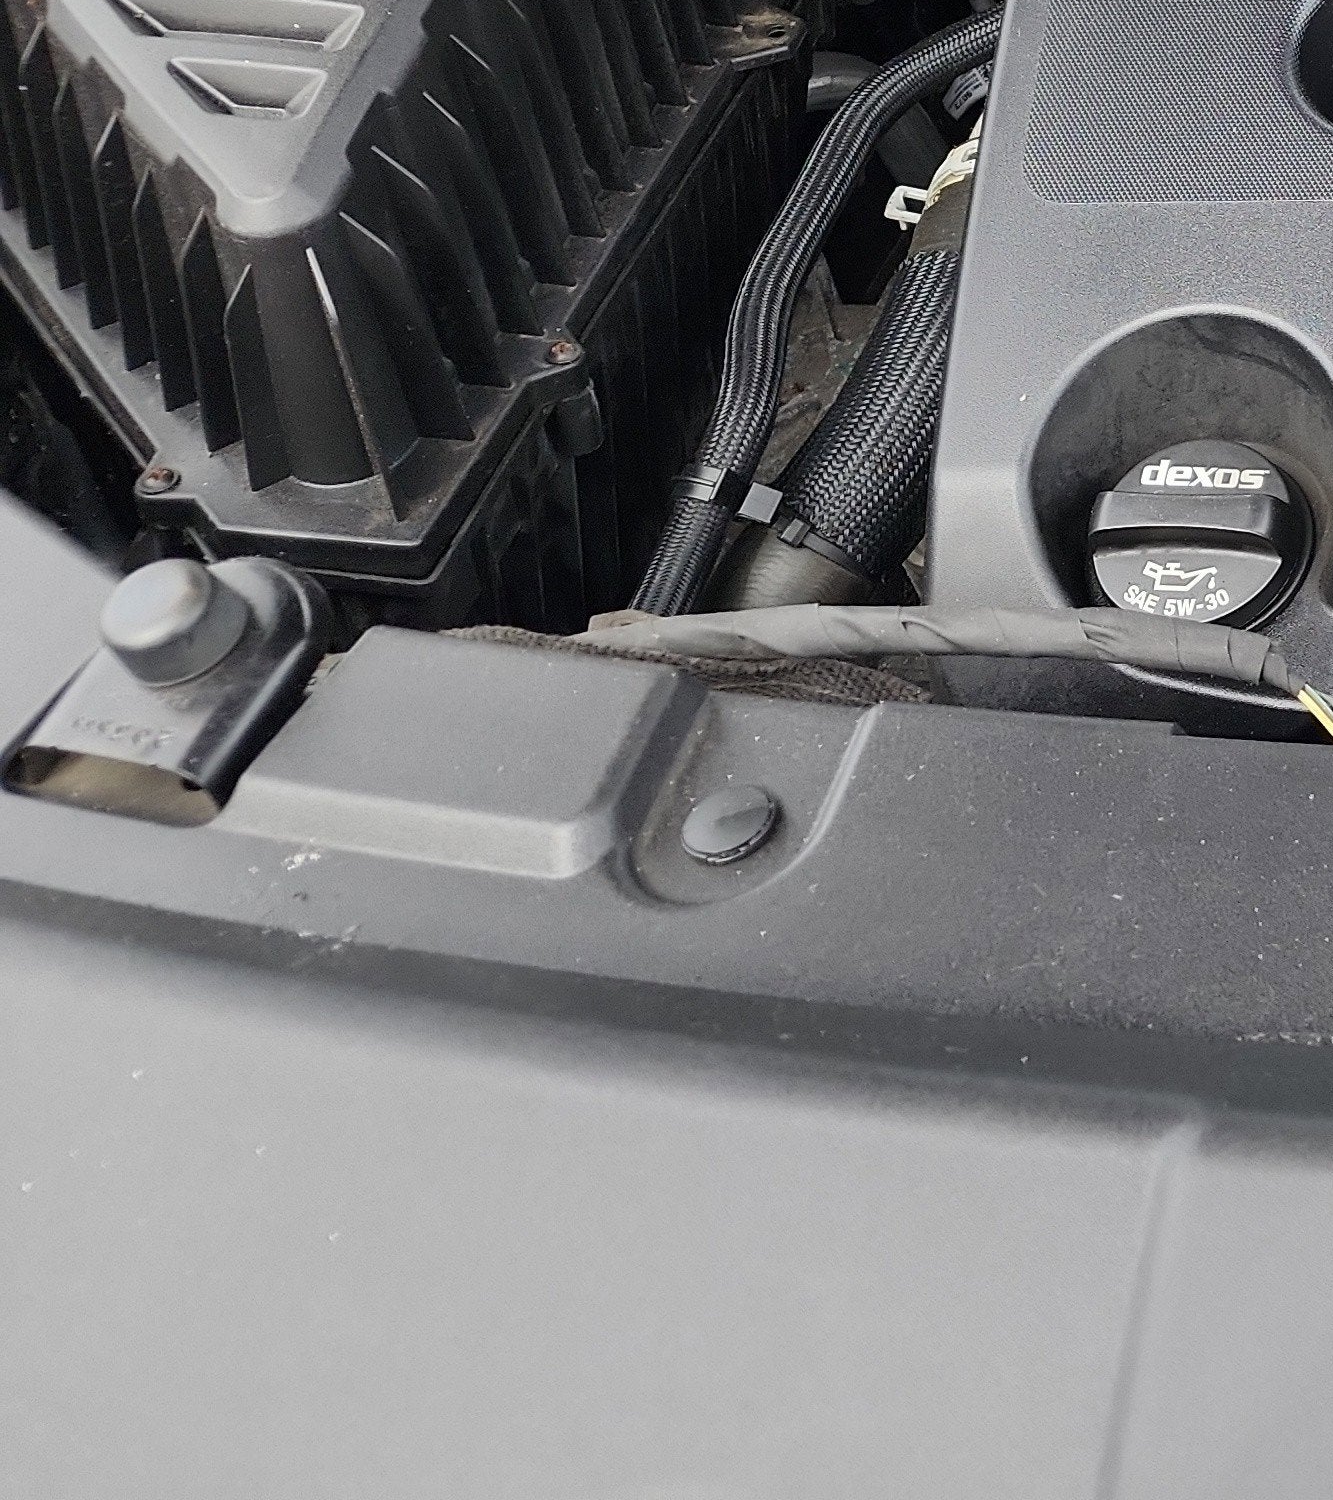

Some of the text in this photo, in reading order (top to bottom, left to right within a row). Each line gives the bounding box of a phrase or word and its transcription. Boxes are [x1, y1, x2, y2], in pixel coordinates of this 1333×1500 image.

[1140, 459, 1271, 490] dexos
[1123, 584, 1230, 617] SAE 5W-30
